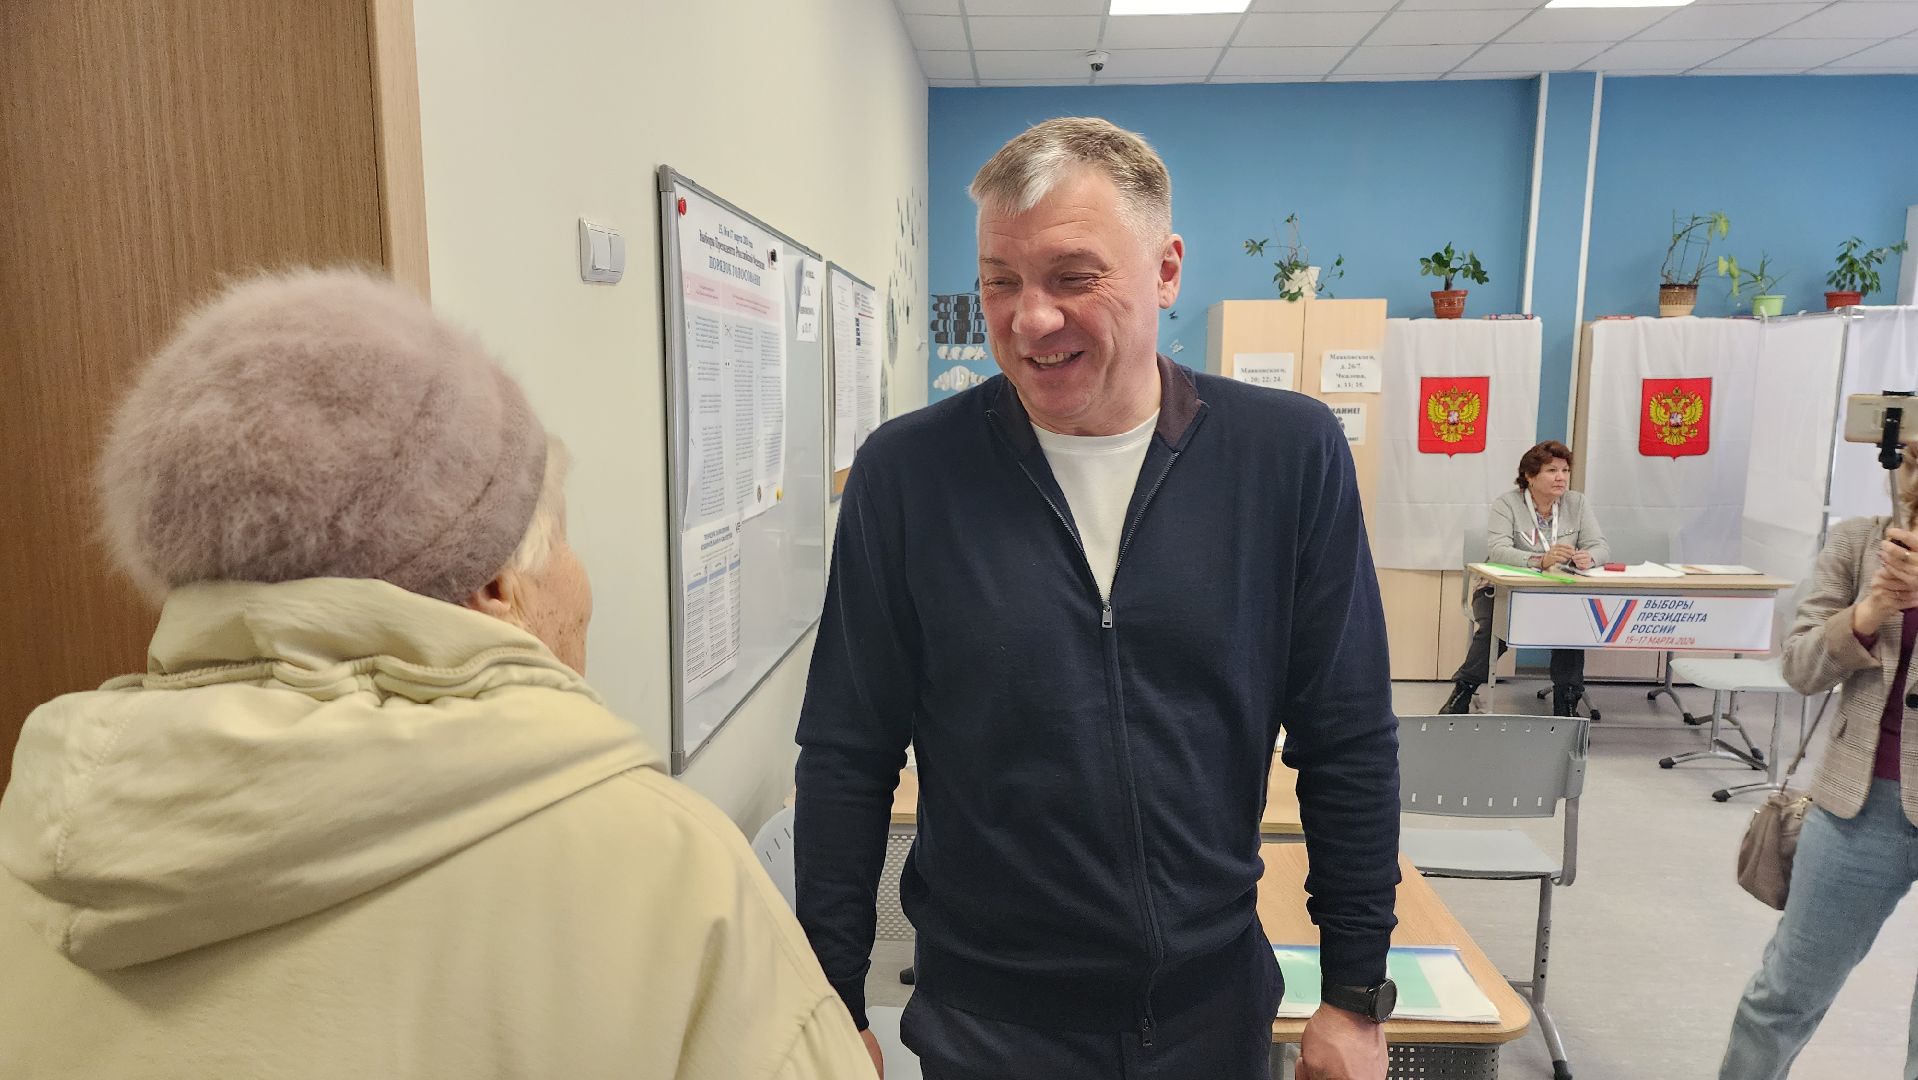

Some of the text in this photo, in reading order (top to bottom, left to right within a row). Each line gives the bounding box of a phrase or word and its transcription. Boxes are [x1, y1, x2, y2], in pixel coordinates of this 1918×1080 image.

[1643, 599, 1695, 610] ВЫБОРЫ
[1636, 611, 1708, 623] ПРЕЗИДЕНТА
[1629, 624, 1676, 634] РОССИИ
[1648, 636, 1675, 645] МАРТА
